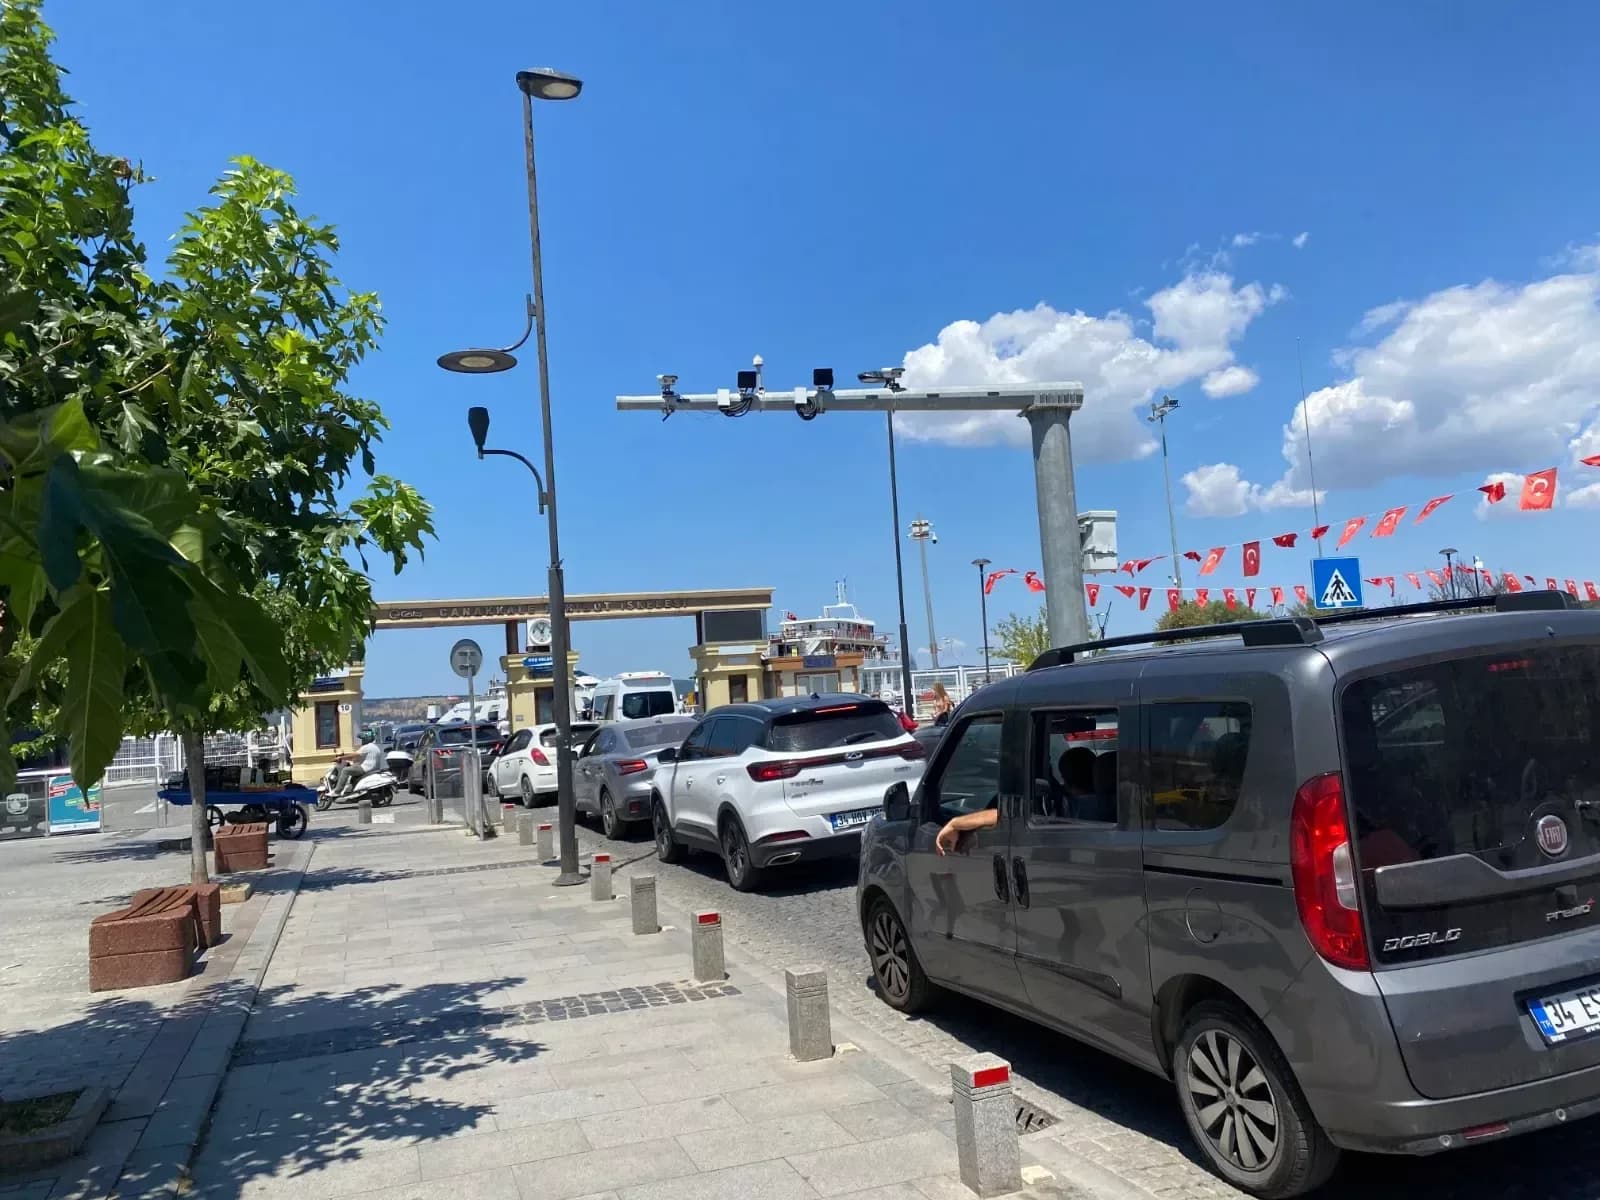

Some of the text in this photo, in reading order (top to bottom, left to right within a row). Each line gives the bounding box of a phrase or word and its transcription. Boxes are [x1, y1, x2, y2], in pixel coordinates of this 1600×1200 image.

[837, 813, 849, 826] 34
[1544, 825, 1562, 844] FIAT
[1382, 928, 1463, 952] DOBLO
[1544, 998, 1577, 1028] 34
